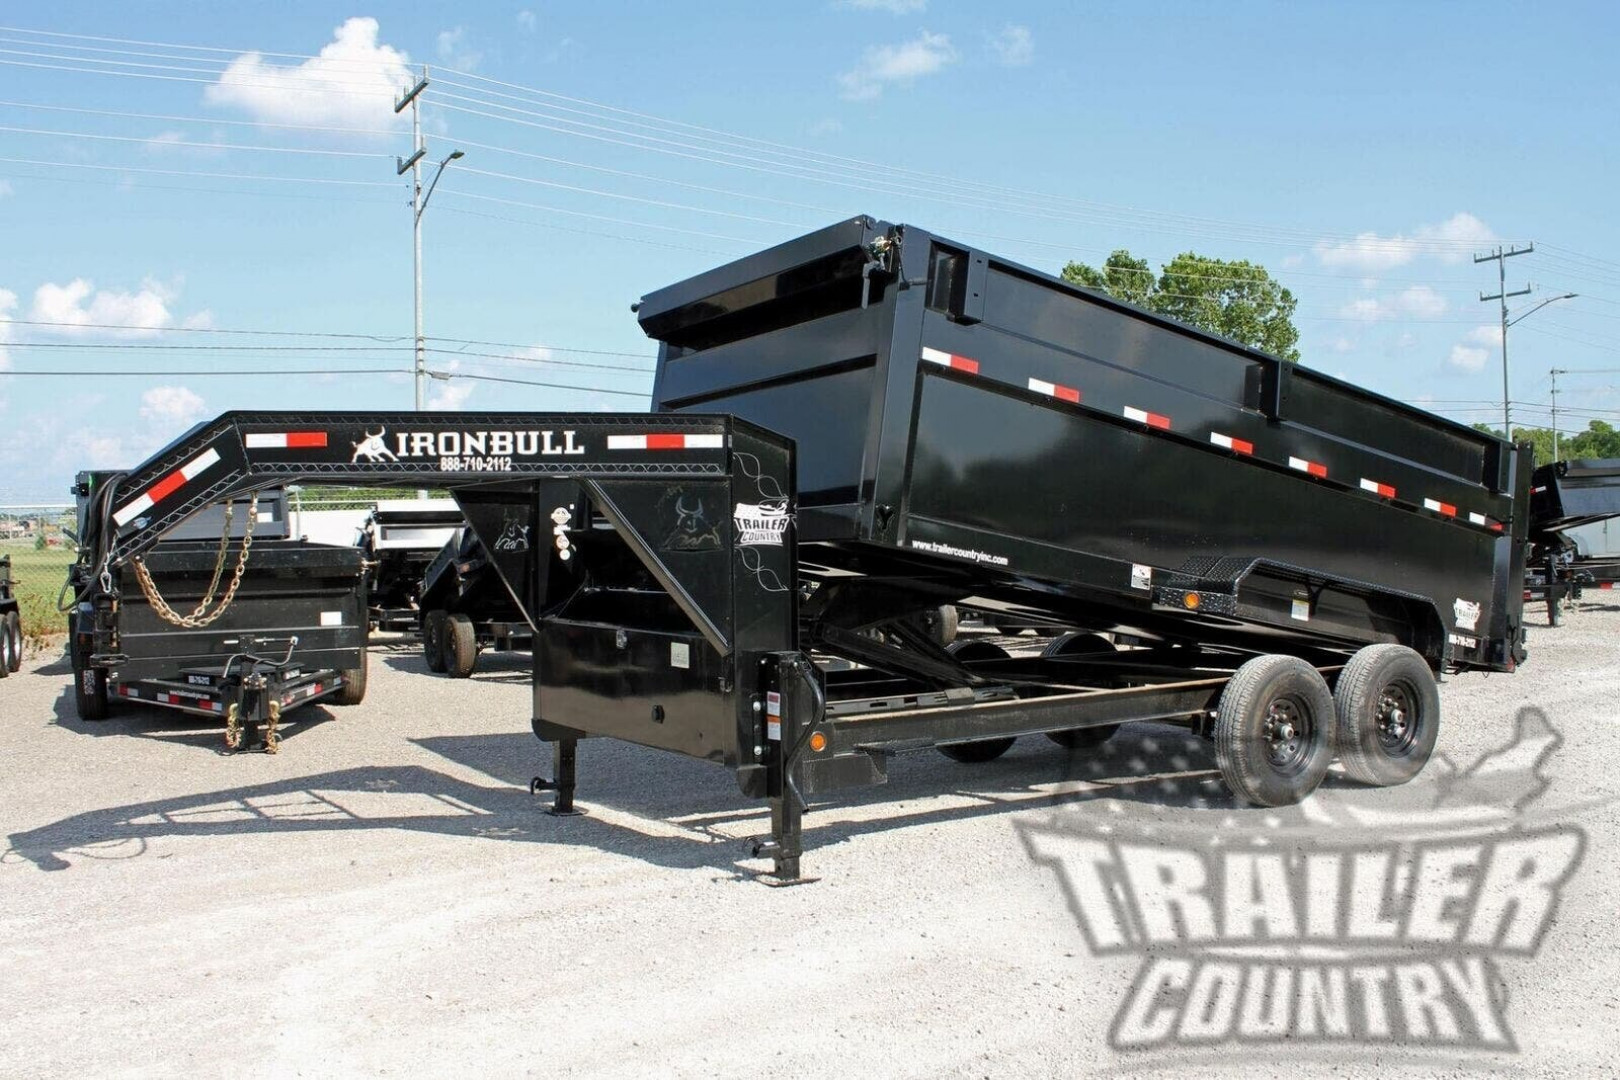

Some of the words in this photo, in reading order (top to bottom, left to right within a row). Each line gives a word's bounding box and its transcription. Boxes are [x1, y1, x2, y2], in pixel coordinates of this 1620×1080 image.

[396, 431, 585, 457] IRONBULL
[440, 457, 512, 472] 888-710-2112
[734, 517, 789, 531] TRAILER
[742, 531, 782, 542] COUNTRY
[912, 540, 1009, 566] www.trailercountryinc.com
